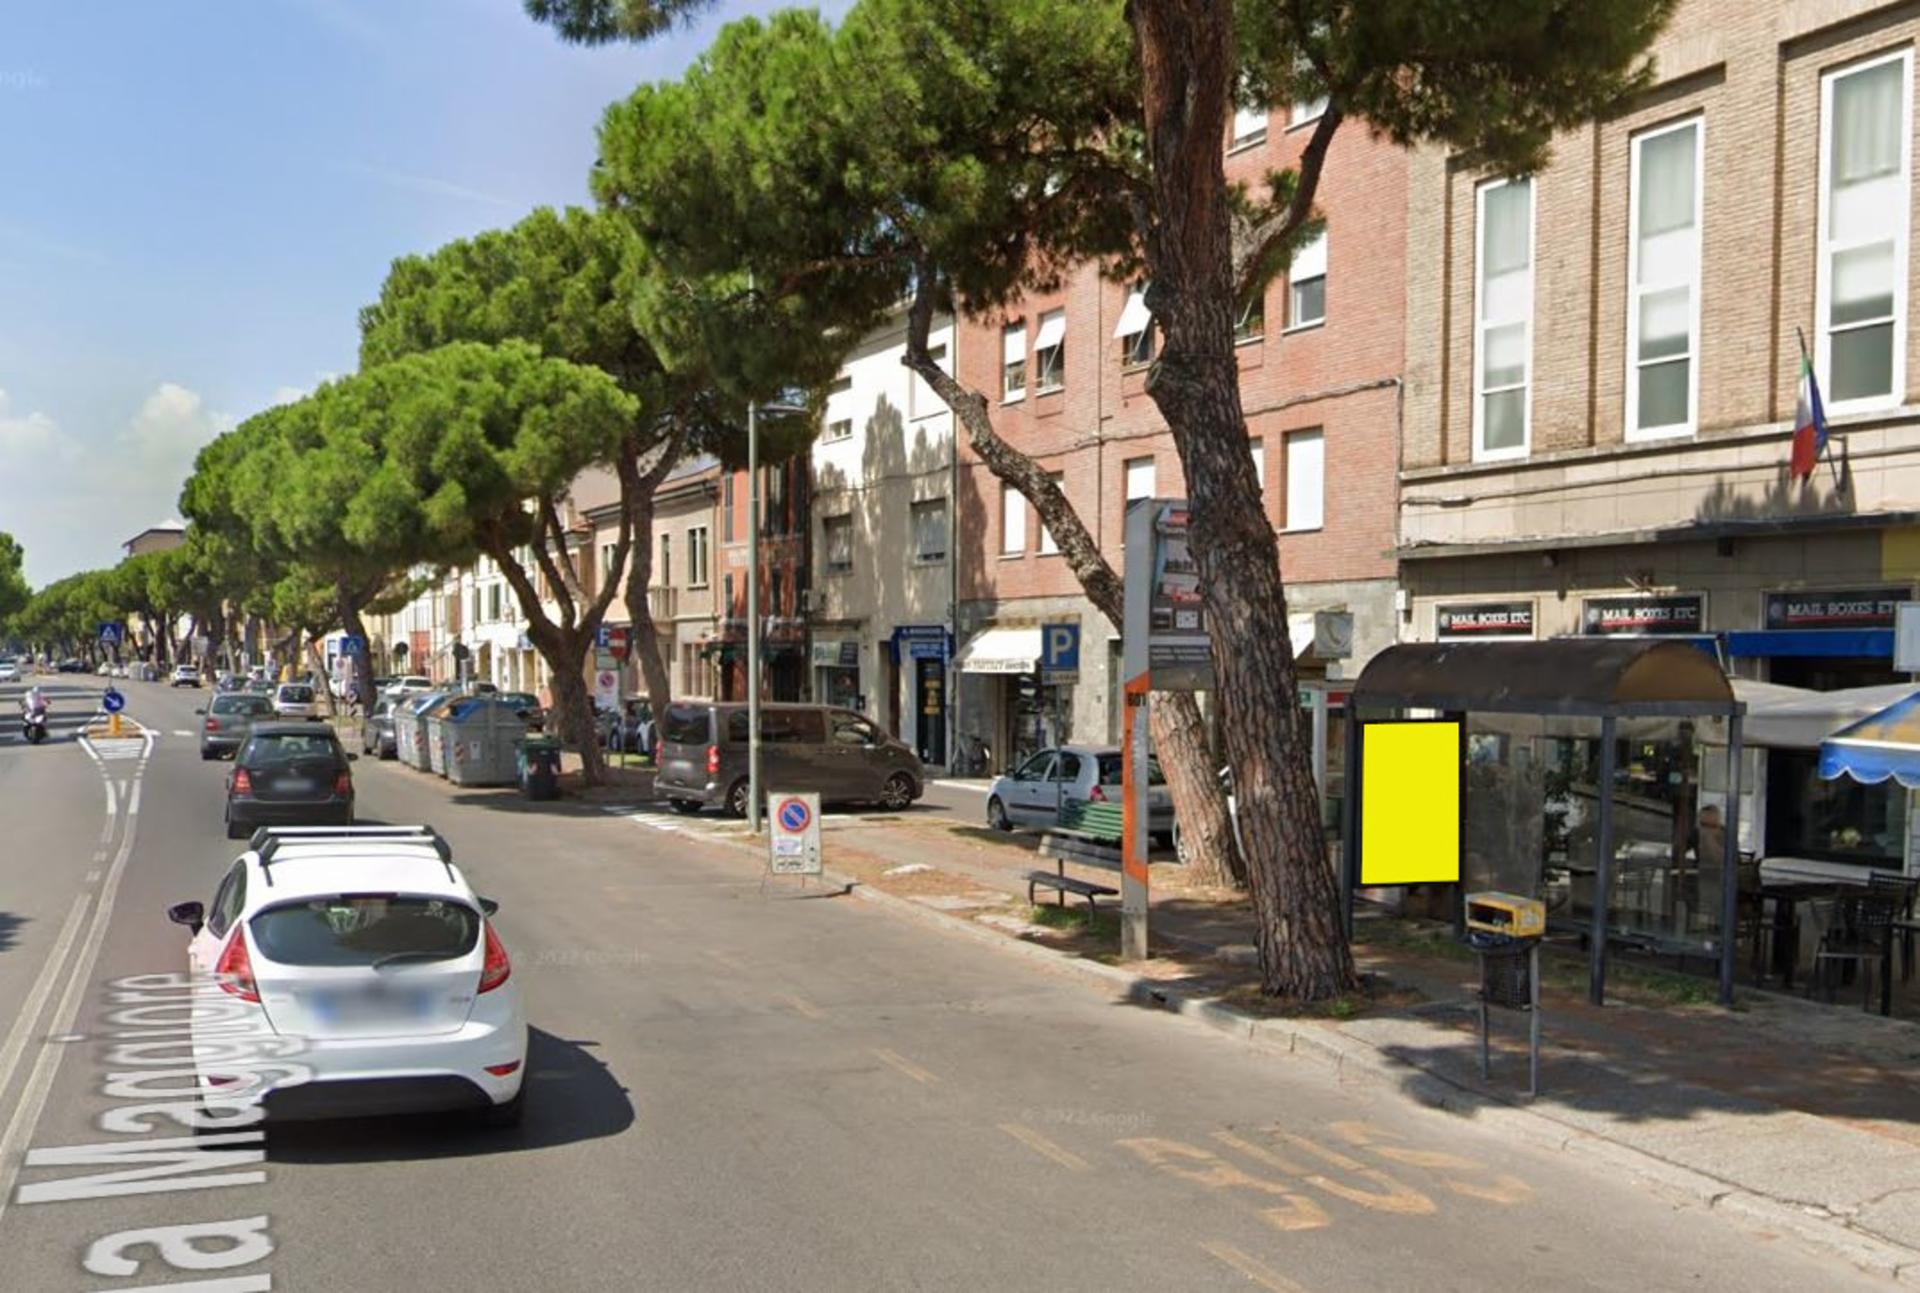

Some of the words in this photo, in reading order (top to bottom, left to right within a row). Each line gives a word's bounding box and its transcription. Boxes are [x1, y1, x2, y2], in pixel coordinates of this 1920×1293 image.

[1602, 609, 1632, 620] MAIL
[1634, 608, 1671, 619] BOXES
[1787, 603, 1825, 616] MAIL
[1827, 602, 1872, 616] BOXES
[1451, 613, 1476, 625] MAIL
[1478, 612, 1508, 625] BOXES
[1050, 628, 1072, 665] P
